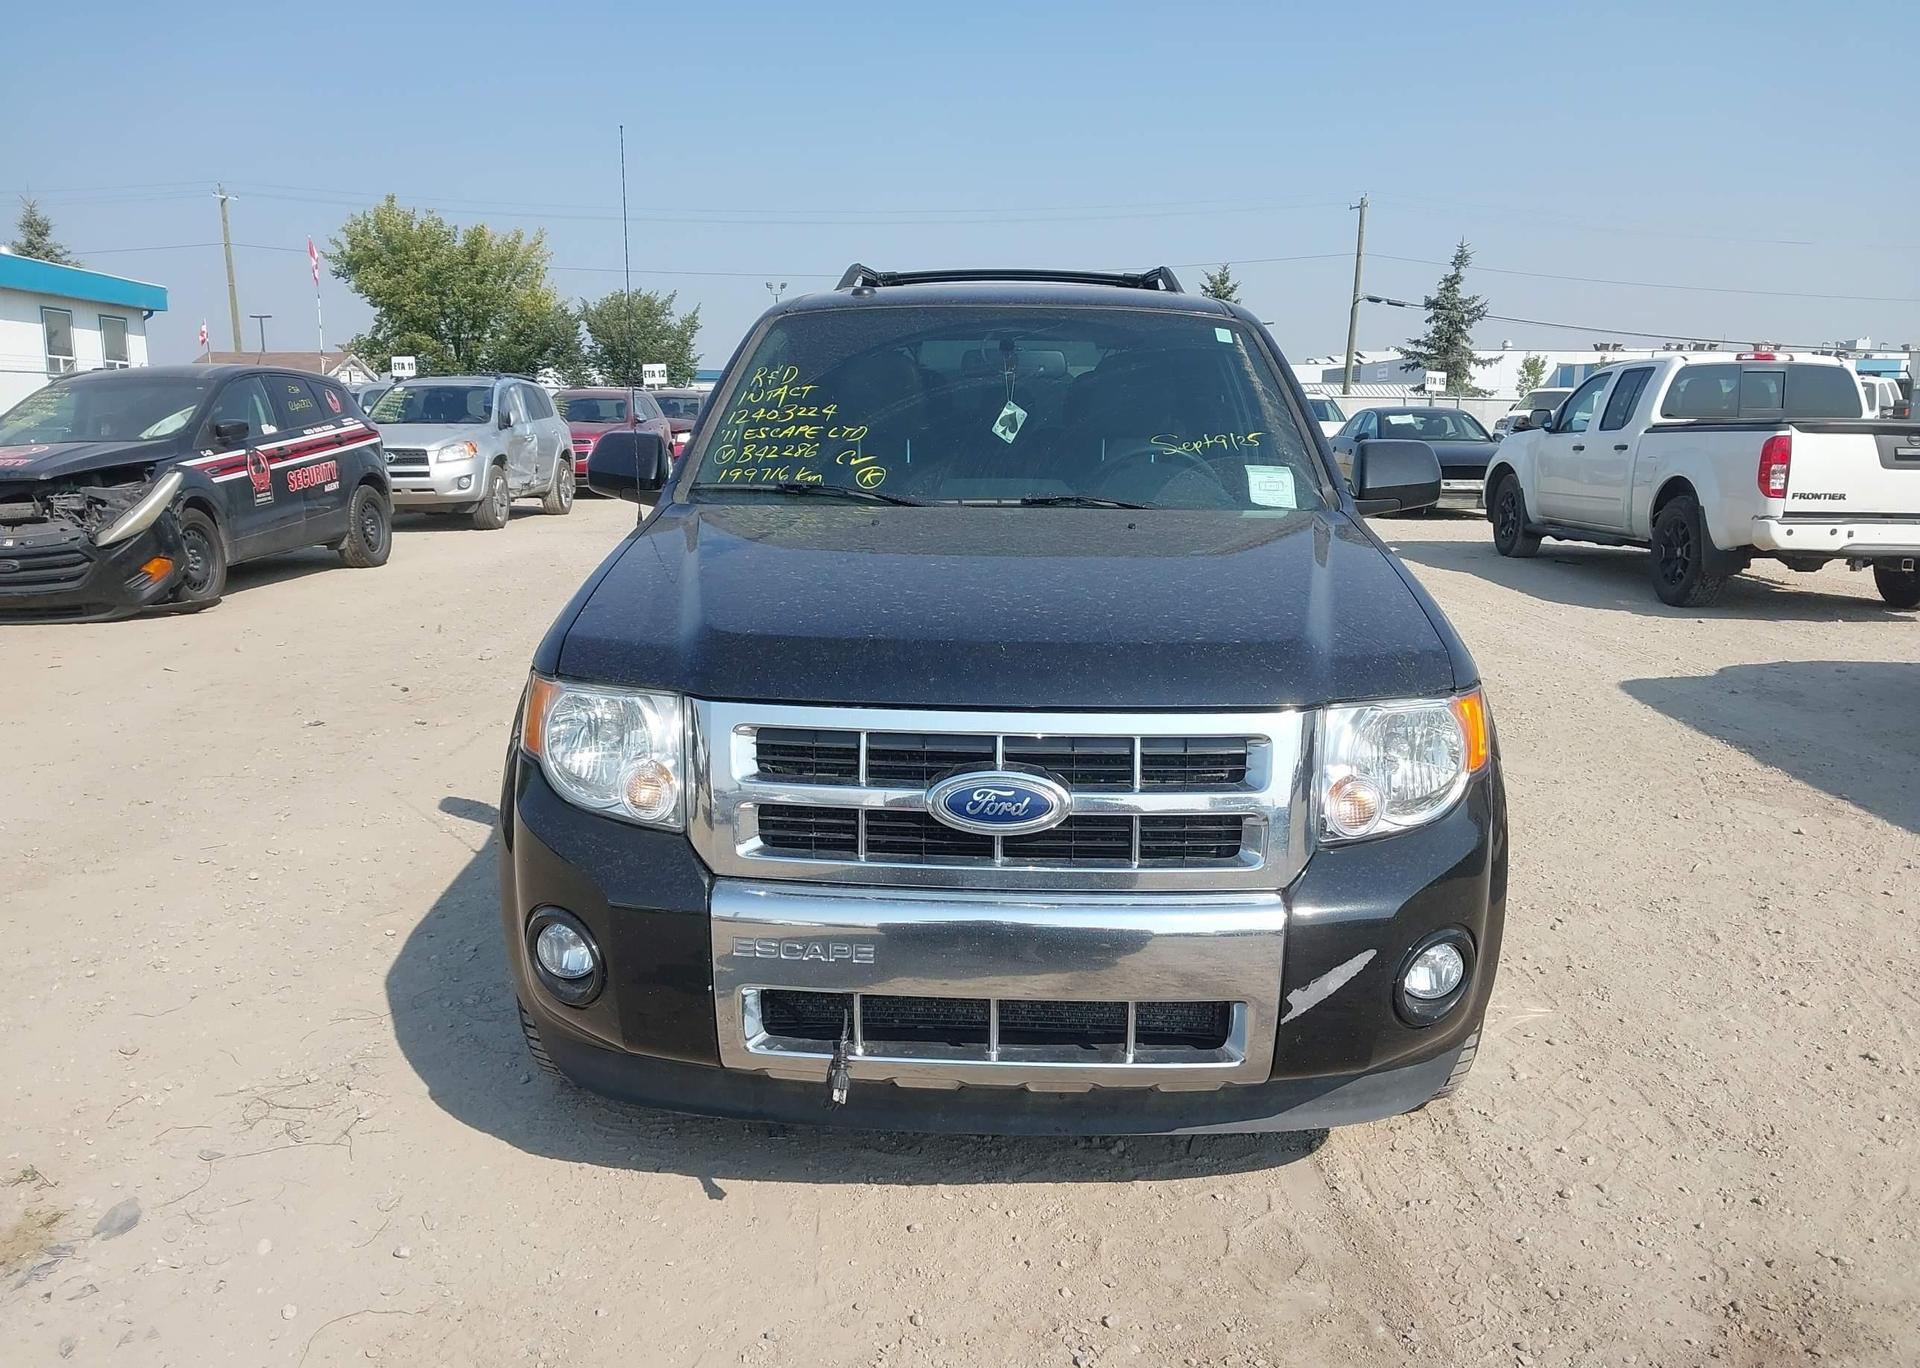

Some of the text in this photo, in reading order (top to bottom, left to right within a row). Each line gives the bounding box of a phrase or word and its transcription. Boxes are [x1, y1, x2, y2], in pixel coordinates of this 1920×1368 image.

[393, 362, 414, 371] ETA 11
[658, 370, 666, 378] 12
[738, 385, 820, 407] INTACT
[727, 404, 838, 426] 12403224
[743, 425, 824, 440] ESCAPE
[828, 425, 868, 441] LTD
[287, 460, 338, 492] SECURITY
[1791, 492, 1847, 500] FRONTIER
[965, 788, 1031, 816] Ford
[732, 936, 875, 964] ESCAPE
